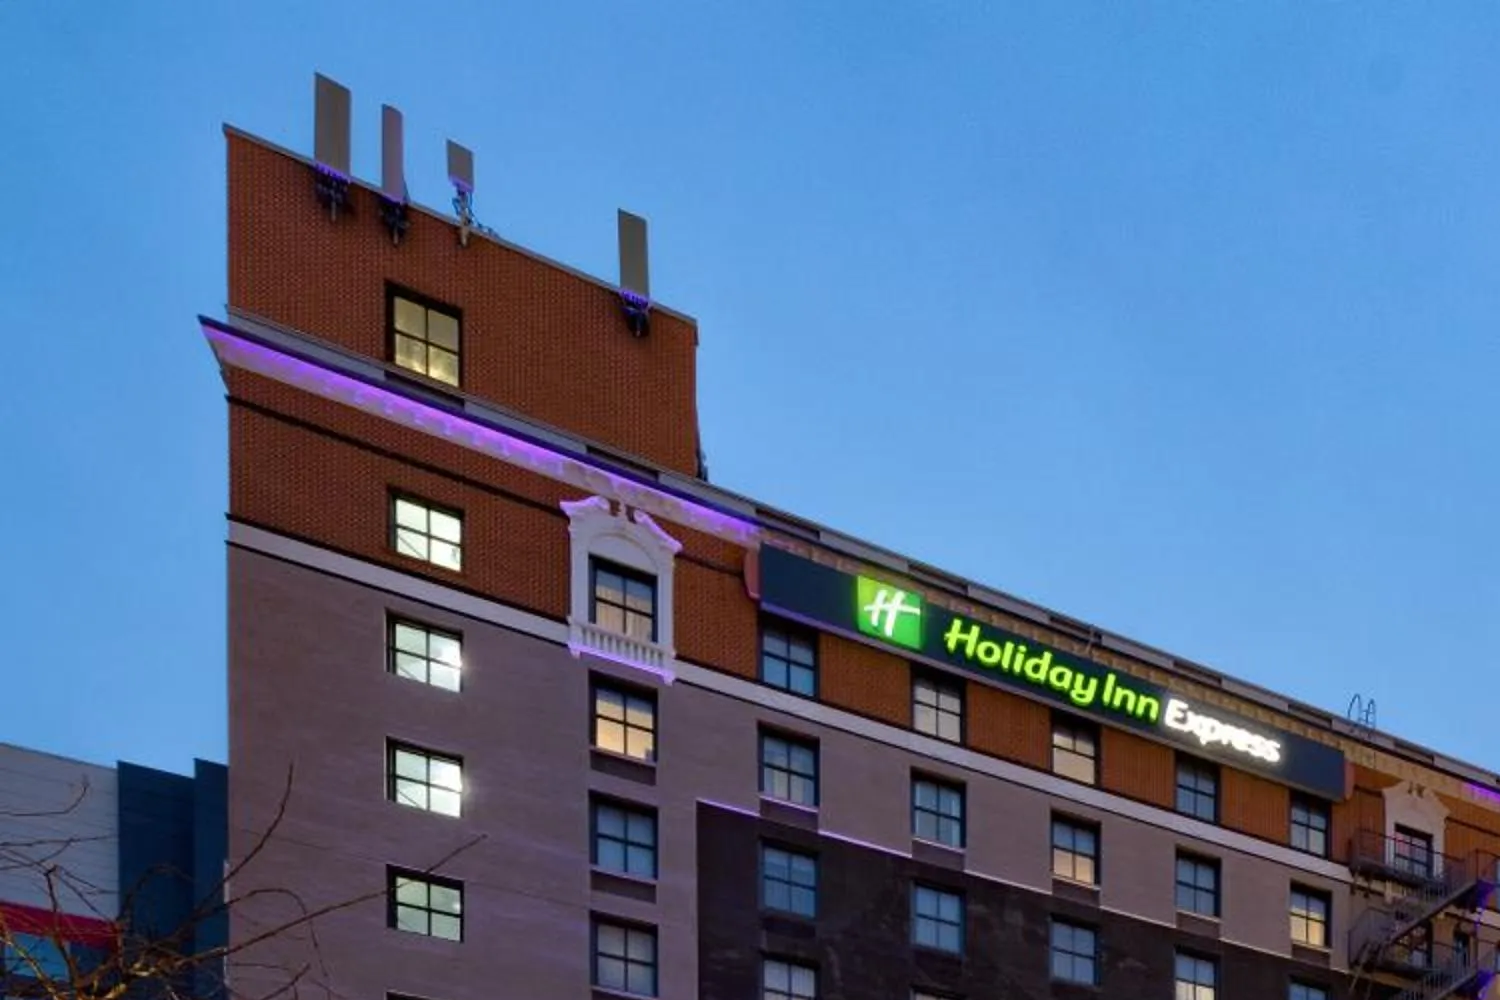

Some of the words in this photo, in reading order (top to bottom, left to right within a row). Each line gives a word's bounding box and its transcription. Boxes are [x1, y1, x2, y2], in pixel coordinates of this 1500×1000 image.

[944, 618, 1098, 706] Holiday
[1103, 672, 1160, 721] Inn
[1164, 697, 1282, 763] Express
